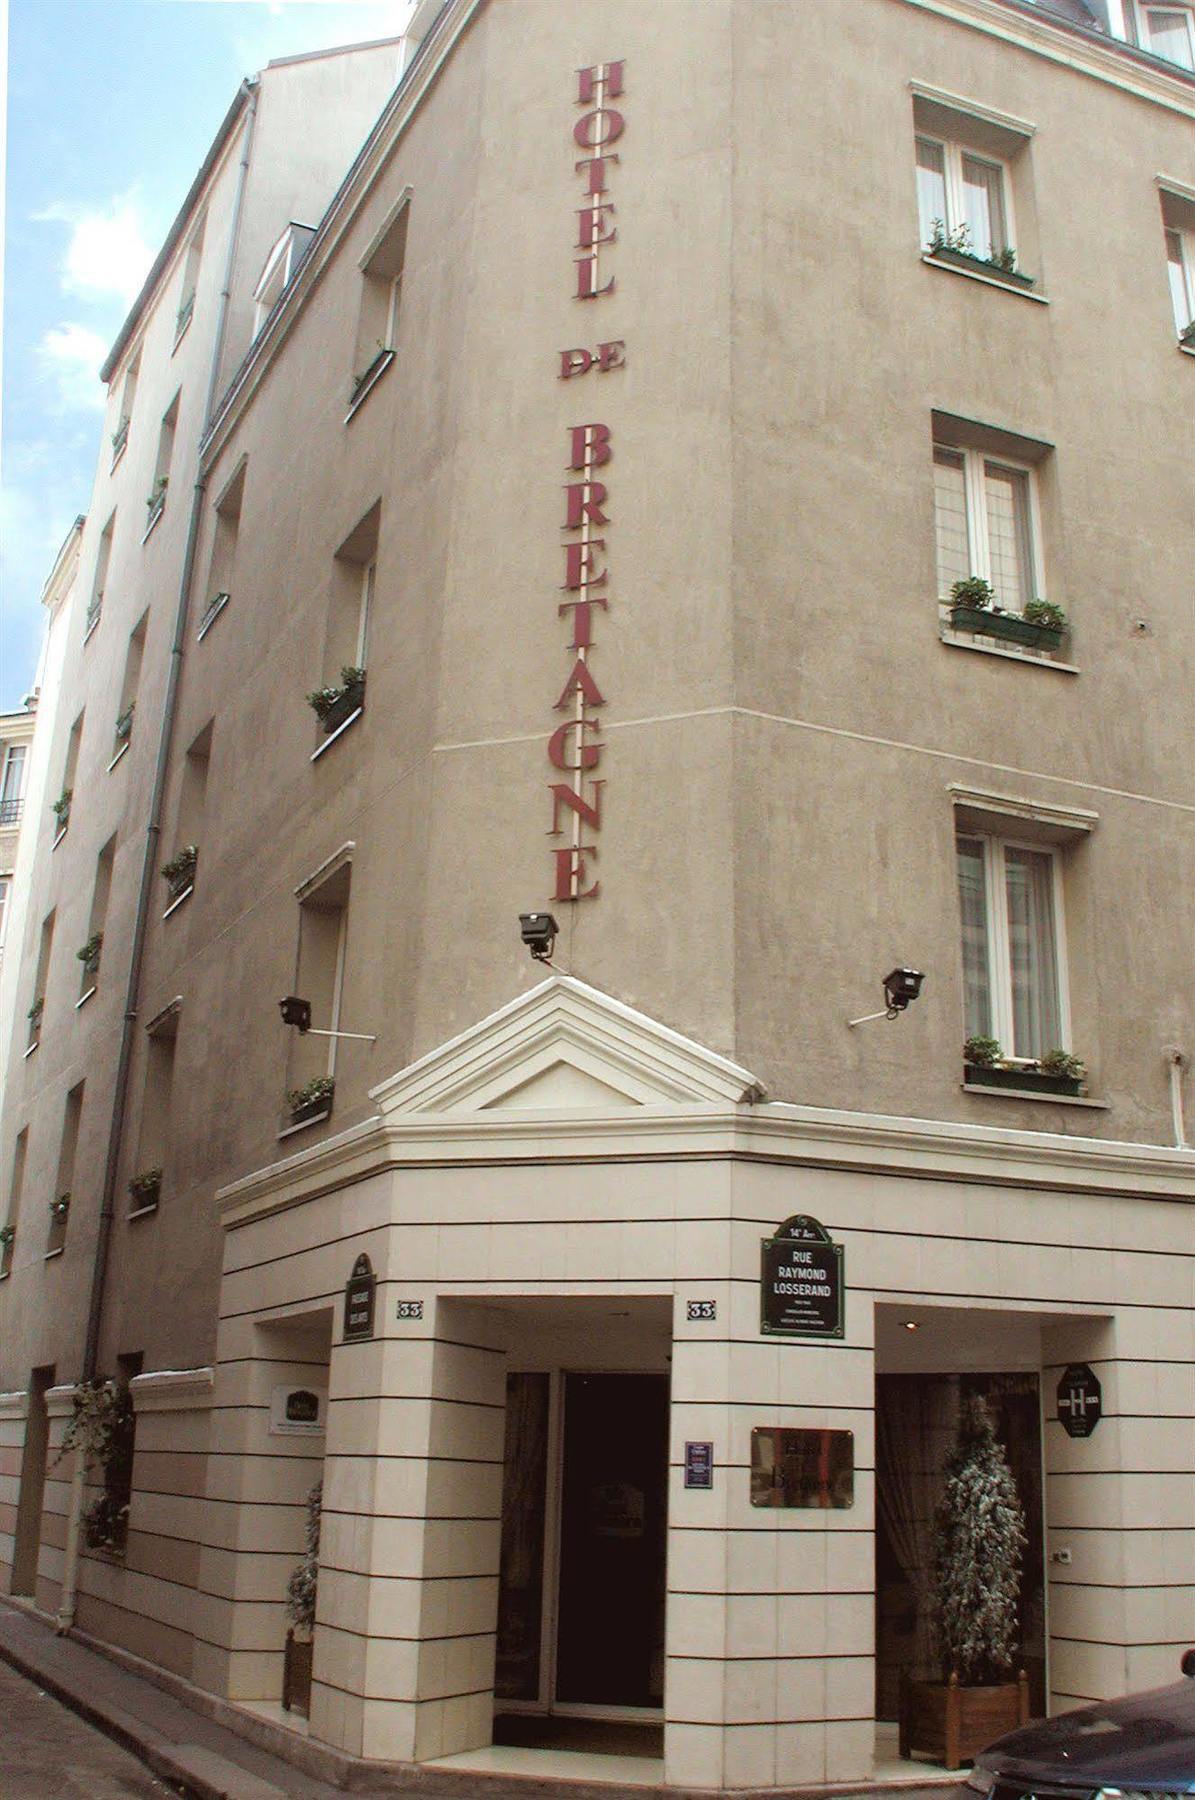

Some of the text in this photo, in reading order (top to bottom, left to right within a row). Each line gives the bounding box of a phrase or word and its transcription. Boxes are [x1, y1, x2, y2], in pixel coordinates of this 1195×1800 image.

[547, 58, 627, 903] HOTEL DE BRETAGNE
[792, 1250, 813, 1264] RUE
[778, 1266, 827, 1281] RAYMOND
[773, 1282, 832, 1298] LOSSERAND
[400, 1303, 421, 1317] 33
[689, 1303, 714, 1318] 33
